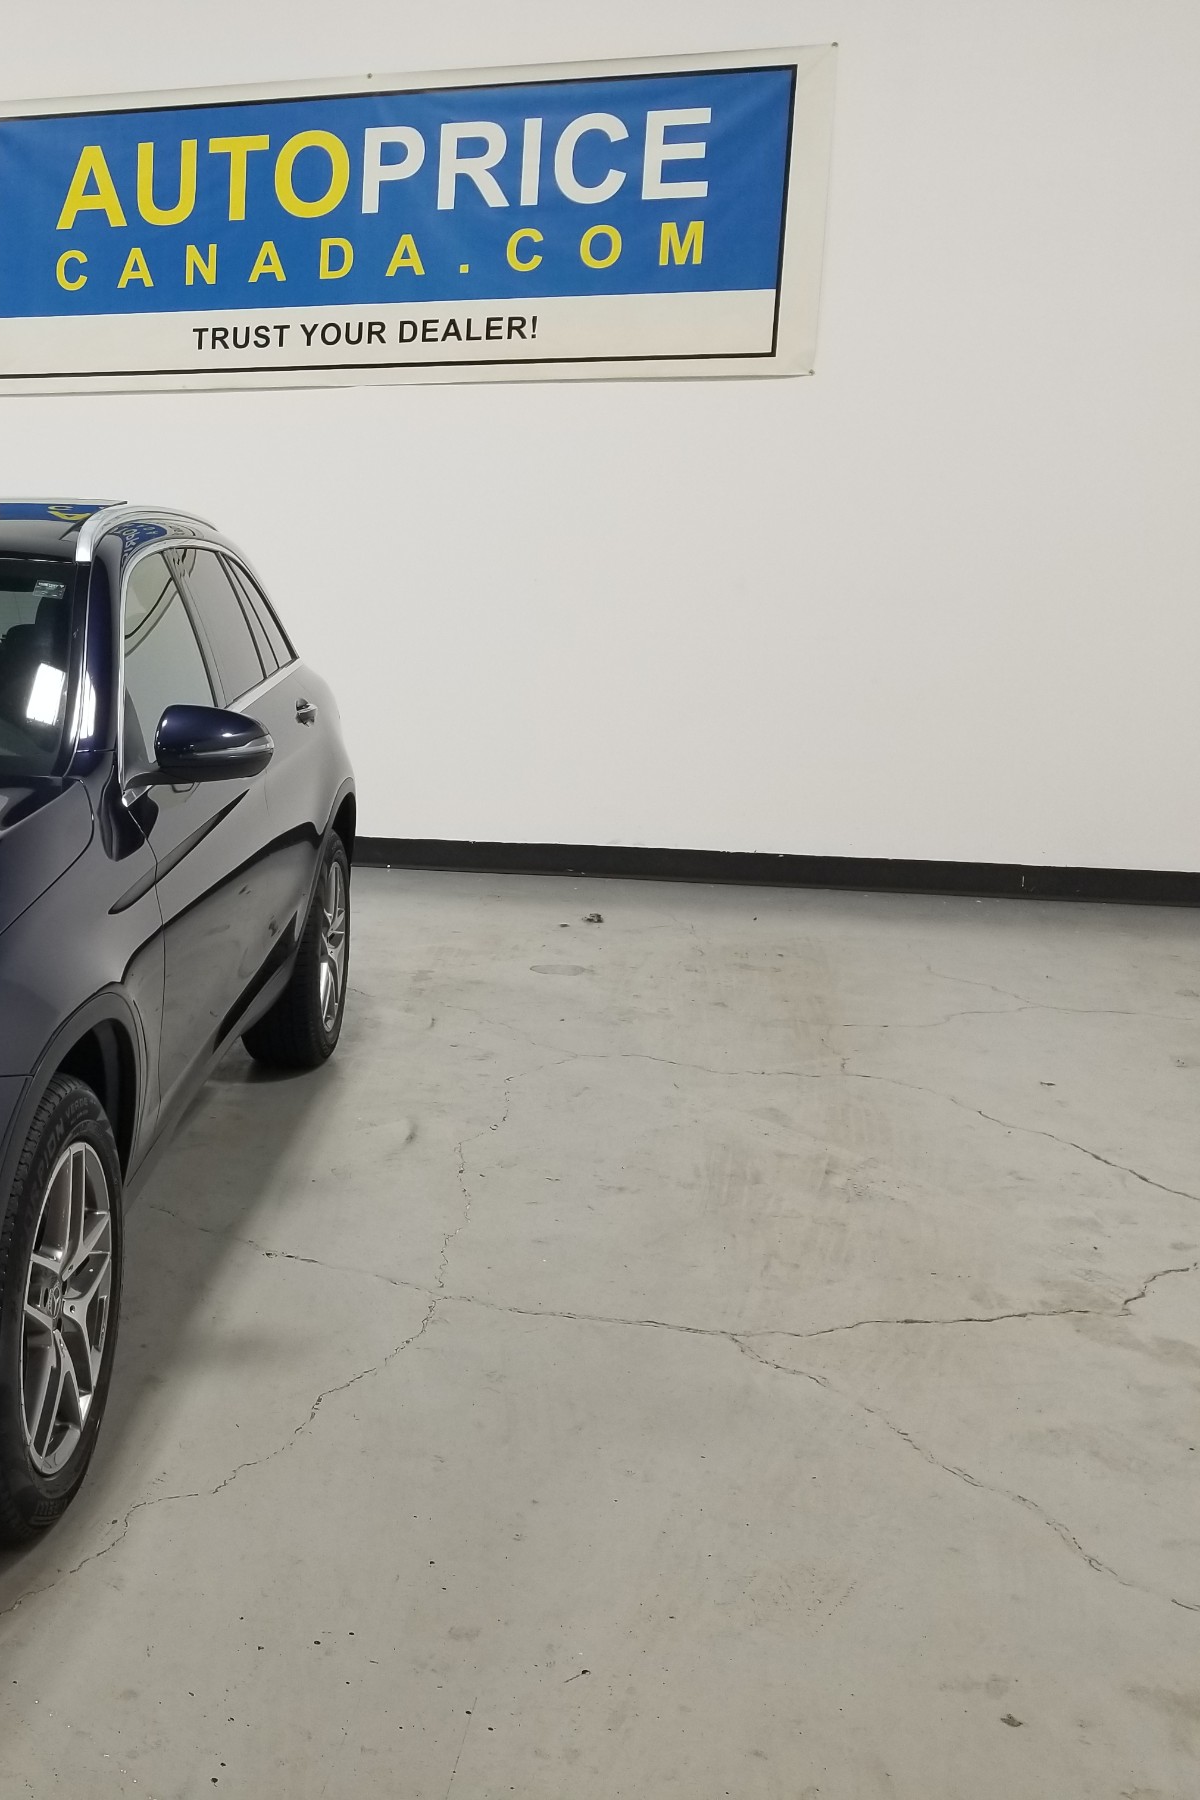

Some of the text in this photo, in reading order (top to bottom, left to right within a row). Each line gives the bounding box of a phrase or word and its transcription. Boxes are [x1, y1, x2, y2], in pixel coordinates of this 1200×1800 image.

[55, 107, 712, 230] AUTOPRICE
[55, 220, 705, 291] CANADA.COM
[192, 315, 538, 350] TRUST YOUR DEALER!
